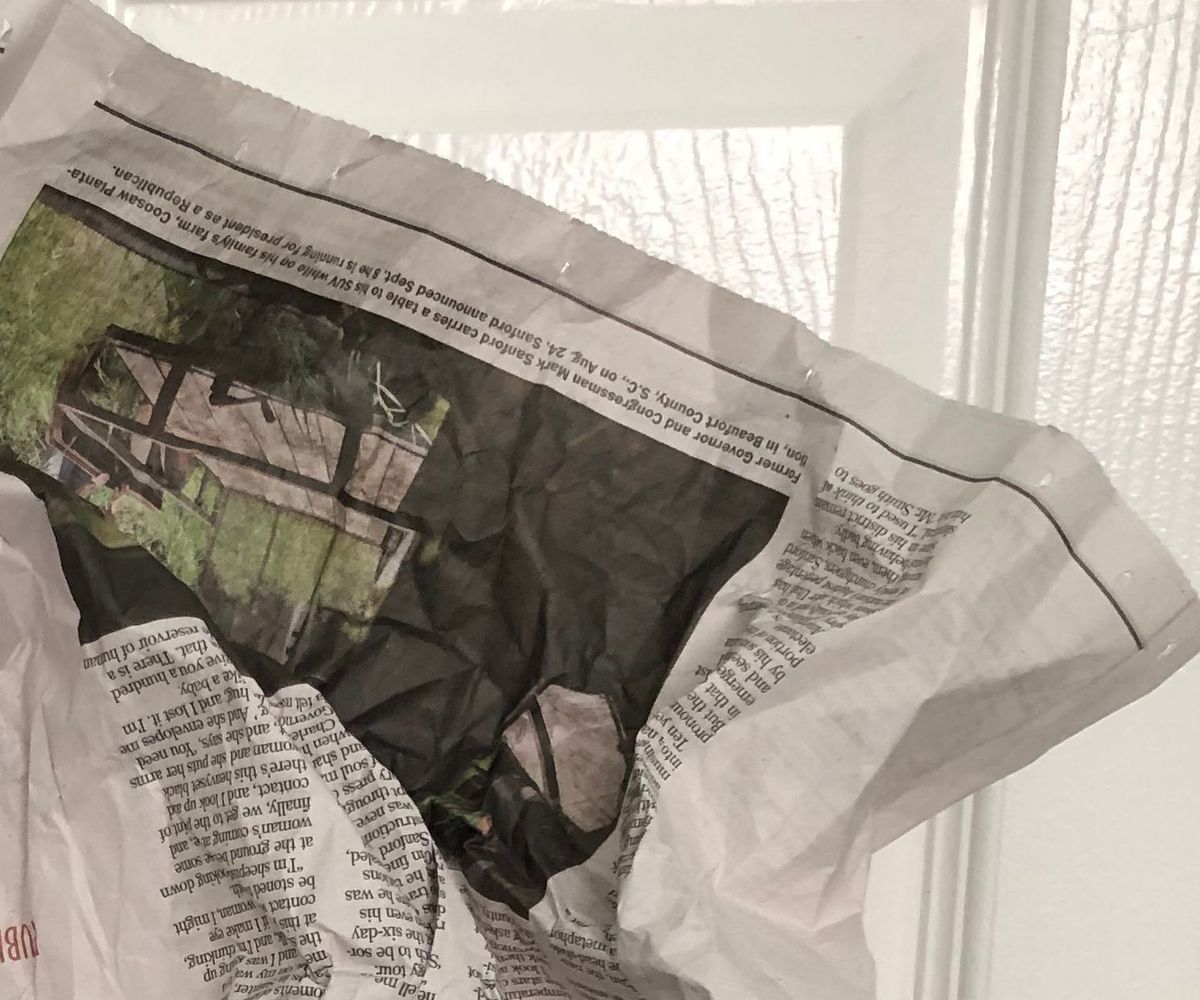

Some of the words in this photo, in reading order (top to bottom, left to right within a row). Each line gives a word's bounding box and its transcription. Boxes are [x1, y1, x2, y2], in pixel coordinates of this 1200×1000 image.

[66, 169, 115, 197] Planta-
[111, 164, 191, 212] Republican.
[111, 188, 171, 224] Coosaw
[193, 203, 202, 214] a
[204, 210, 221, 225] as
[174, 215, 208, 242] farm,
[222, 216, 282, 247] president
[280, 236, 301, 255] for
[259, 249, 277, 266] his
[279, 255, 295, 268] on
[301, 245, 344, 268] running
[296, 263, 328, 280] while
[346, 260, 356, 273] is
[358, 263, 372, 276] he
[328, 274, 353, 291] SUV
[383, 269, 415, 292] Sept.
[370, 285, 382, 299] to
[385, 290, 417, 313] table
[415, 283, 487, 322] announced
[421, 306, 430, 317] a
[432, 311, 478, 339] carries
[488, 316, 542, 349] Sanford
[479, 332, 534, 365] Sanford
[535, 357, 570, 380] Mark
[599, 367, 617, 384] on
[621, 375, 651, 398] S.C.,
[571, 373, 662, 425] Congressman
[655, 390, 703, 423] County,
[663, 416, 691, 437] and
[704, 415, 764, 448] Beaufort
[692, 430, 753, 463] Governor
[765, 441, 779, 454] in
[755, 456, 801, 484] Former
[833, 466, 848, 483] to
[849, 475, 879, 499] goes
[833, 485, 865, 509] think
[877, 489, 911, 514] Smith
[864, 501, 879, 514] to
[878, 506, 907, 530] used
[138, 625, 198, 651] reservoir
[119, 642, 135, 660] of
[174, 639, 207, 658] that.
[132, 650, 174, 673] There
[178, 658, 204, 678] you
[105, 669, 115, 681] a
[117, 666, 130, 682] is
[168, 667, 176, 678] a
[211, 674, 219, 685] a
[110, 671, 168, 703] hundred
[177, 679, 209, 696] baby.
[162, 703, 187, 721] lost
[189, 701, 198, 715] I
[199, 694, 221, 711] and
[147, 712, 160, 726] it.
[141, 718, 204, 747] envelopes
[119, 740, 139, 753] me
[135, 749, 167, 769] need
[129, 769, 162, 789] arms
[165, 763, 183, 778] her
[242, 804, 261, 818] we
[265, 796, 311, 815] finally,
[159, 877, 194, 898] down
[252, 876, 294, 896] stoned
[298, 875, 315, 889] be
[359, 907, 381, 921] his
[386, 909, 412, 921] even
[351, 925, 402, 942] six-day
